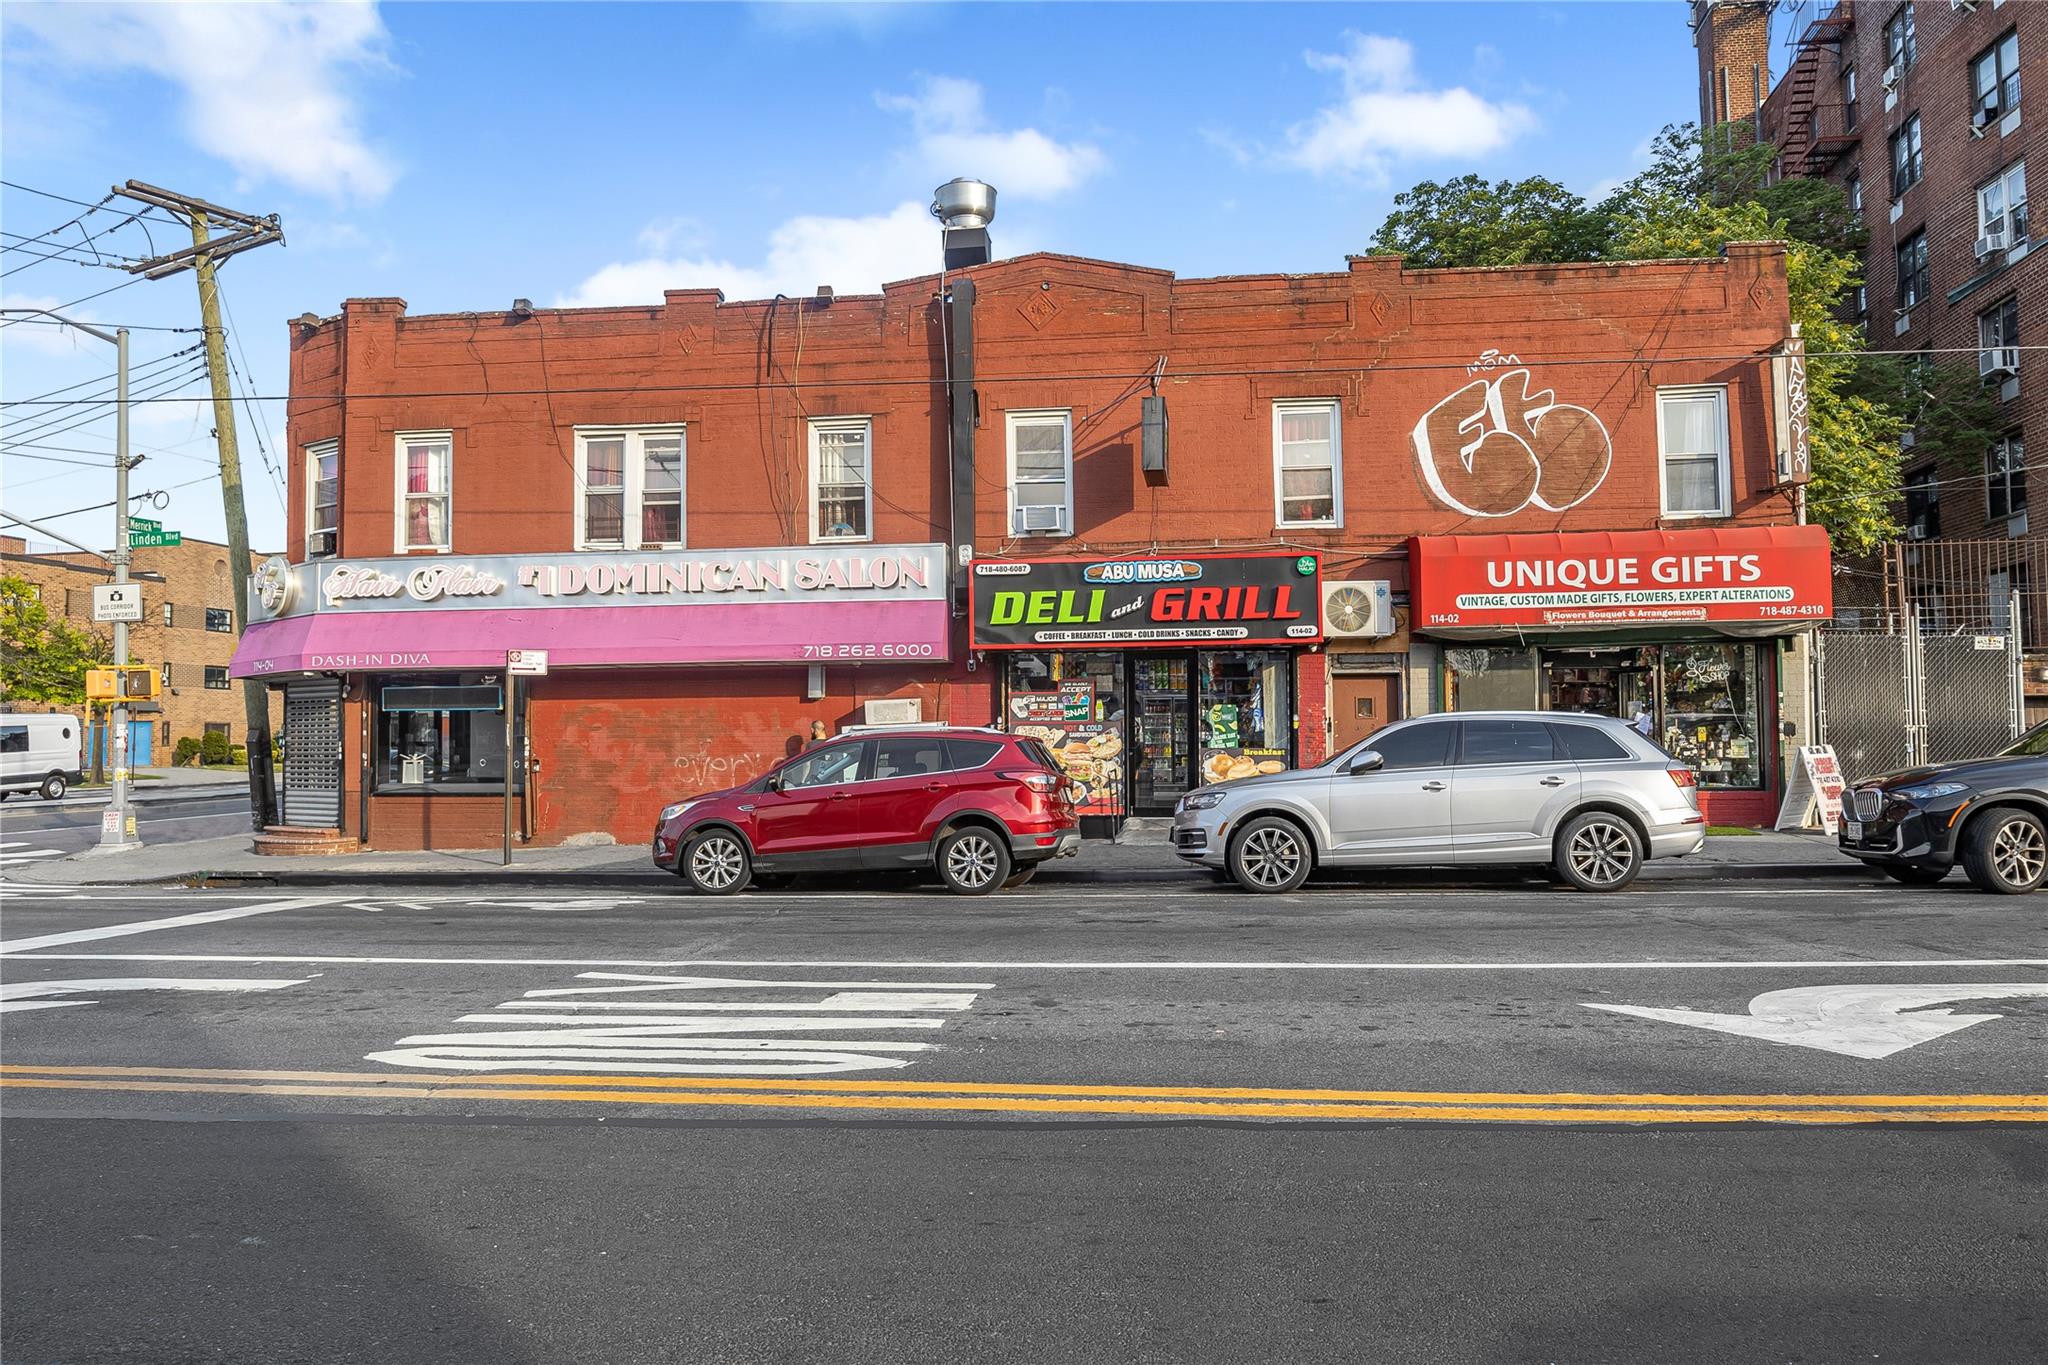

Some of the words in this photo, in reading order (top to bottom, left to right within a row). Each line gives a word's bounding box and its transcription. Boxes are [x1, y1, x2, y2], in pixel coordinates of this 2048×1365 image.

[130, 519, 152, 532] Merrick
[131, 534, 162, 545] Linden
[979, 565, 1027, 573] 718-480-6087
[1100, 562, 1134, 579] ABU
[1136, 561, 1185, 579] MUSA
[1486, 557, 1639, 589] UNIQUE
[1651, 554, 1762, 584] GIFTS
[517, 564, 556, 596] #1
[558, 558, 787, 595] DOMINICAN
[794, 555, 930, 590] SALON
[323, 564, 403, 606] Hair
[406, 563, 501, 601] Flair
[1460, 596, 1508, 607] VINTAGE,
[1510, 595, 1555, 606] CUSTOM
[1556, 594, 1588, 605] MADE
[1589, 593, 1623, 605] GIFTS,
[1625, 591, 1677, 603] FLOWERS,
[1679, 590, 1719, 601] EXPERT
[1721, 588, 1791, 600] ALTERATIONS
[989, 589, 1106, 625] DELI
[1110, 595, 1145, 621] and
[1150, 585, 1302, 622] GRILL
[1760, 605, 1824, 616] 718-487-4310
[1430, 614, 1460, 624] 114-02
[1588, 611, 1626, 619] Bouquet
[1637, 608, 1701, 618] Arrangements
[1043, 632, 1066, 640] COFFEE
[1070, 631, 1107, 639] BREAKFAST
[1111, 631, 1133, 639] LUNCH
[1137, 630, 1155, 638] COLD
[1156, 630, 1180, 638] DRINKS
[1185, 629, 1212, 637] SNACKS
[1216, 629, 1238, 637] CANDY
[804, 644, 932, 658] 718.262.6000
[253, 660, 274, 672] 114-04
[311, 653, 383, 667] DASH-IN
[390, 653, 431, 665] DIVA
[1710, 670, 1730, 681] SHOP
[1065, 706, 1089, 718] SNAP
[1078, 724, 1085, 732] &
[1086, 724, 1103, 732] COLD
[1243, 748, 1286, 756] Breakfast
